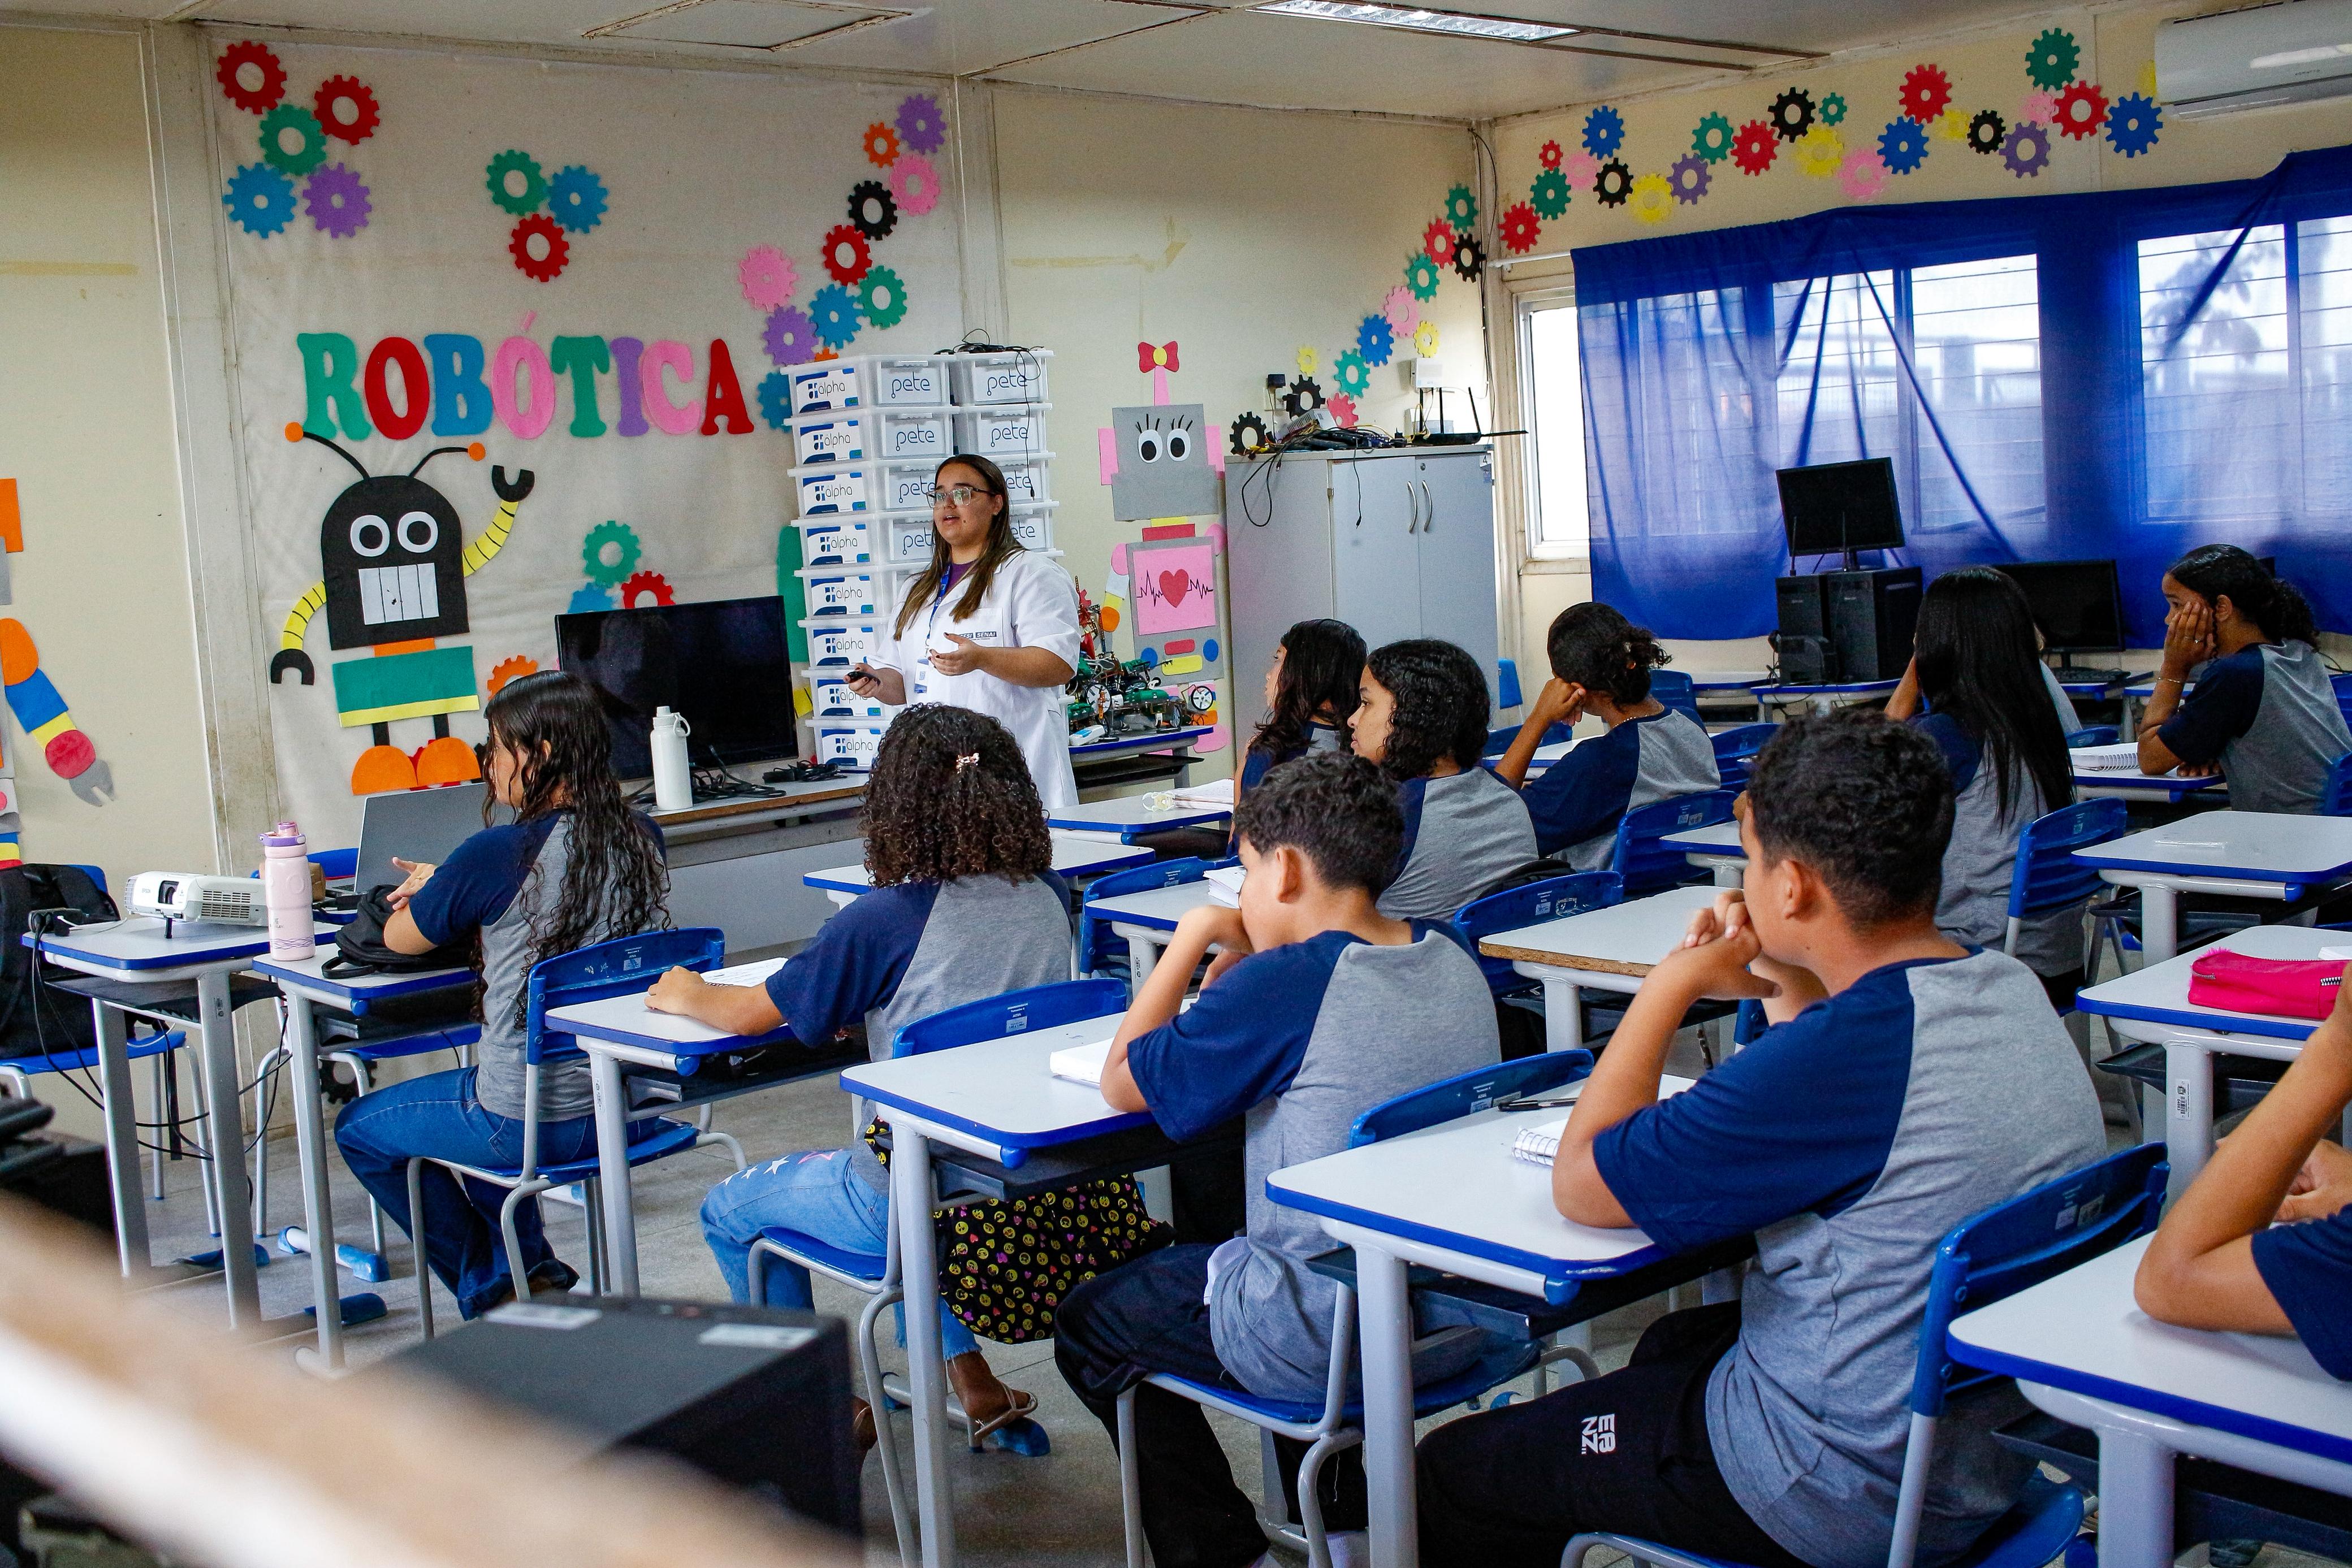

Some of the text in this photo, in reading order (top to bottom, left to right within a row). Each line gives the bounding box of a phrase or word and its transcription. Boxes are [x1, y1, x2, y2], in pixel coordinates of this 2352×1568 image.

[296, 310, 754, 441] ROBÓTICA
[891, 371, 931, 399] pete
[987, 369, 1027, 396] pete
[818, 380, 845, 397] alpha
[824, 432, 851, 449] alpha
[896, 423, 935, 451] pete
[990, 420, 1028, 448] pete
[1006, 470, 1032, 489] ete
[825, 483, 853, 500] alpha
[1011, 520, 1036, 539] ete
[831, 535, 858, 552] alpha
[902, 527, 932, 556] pet
[836, 586, 863, 602] alpha
[836, 637, 864, 653] alpha
[846, 738, 873, 753] alpha
